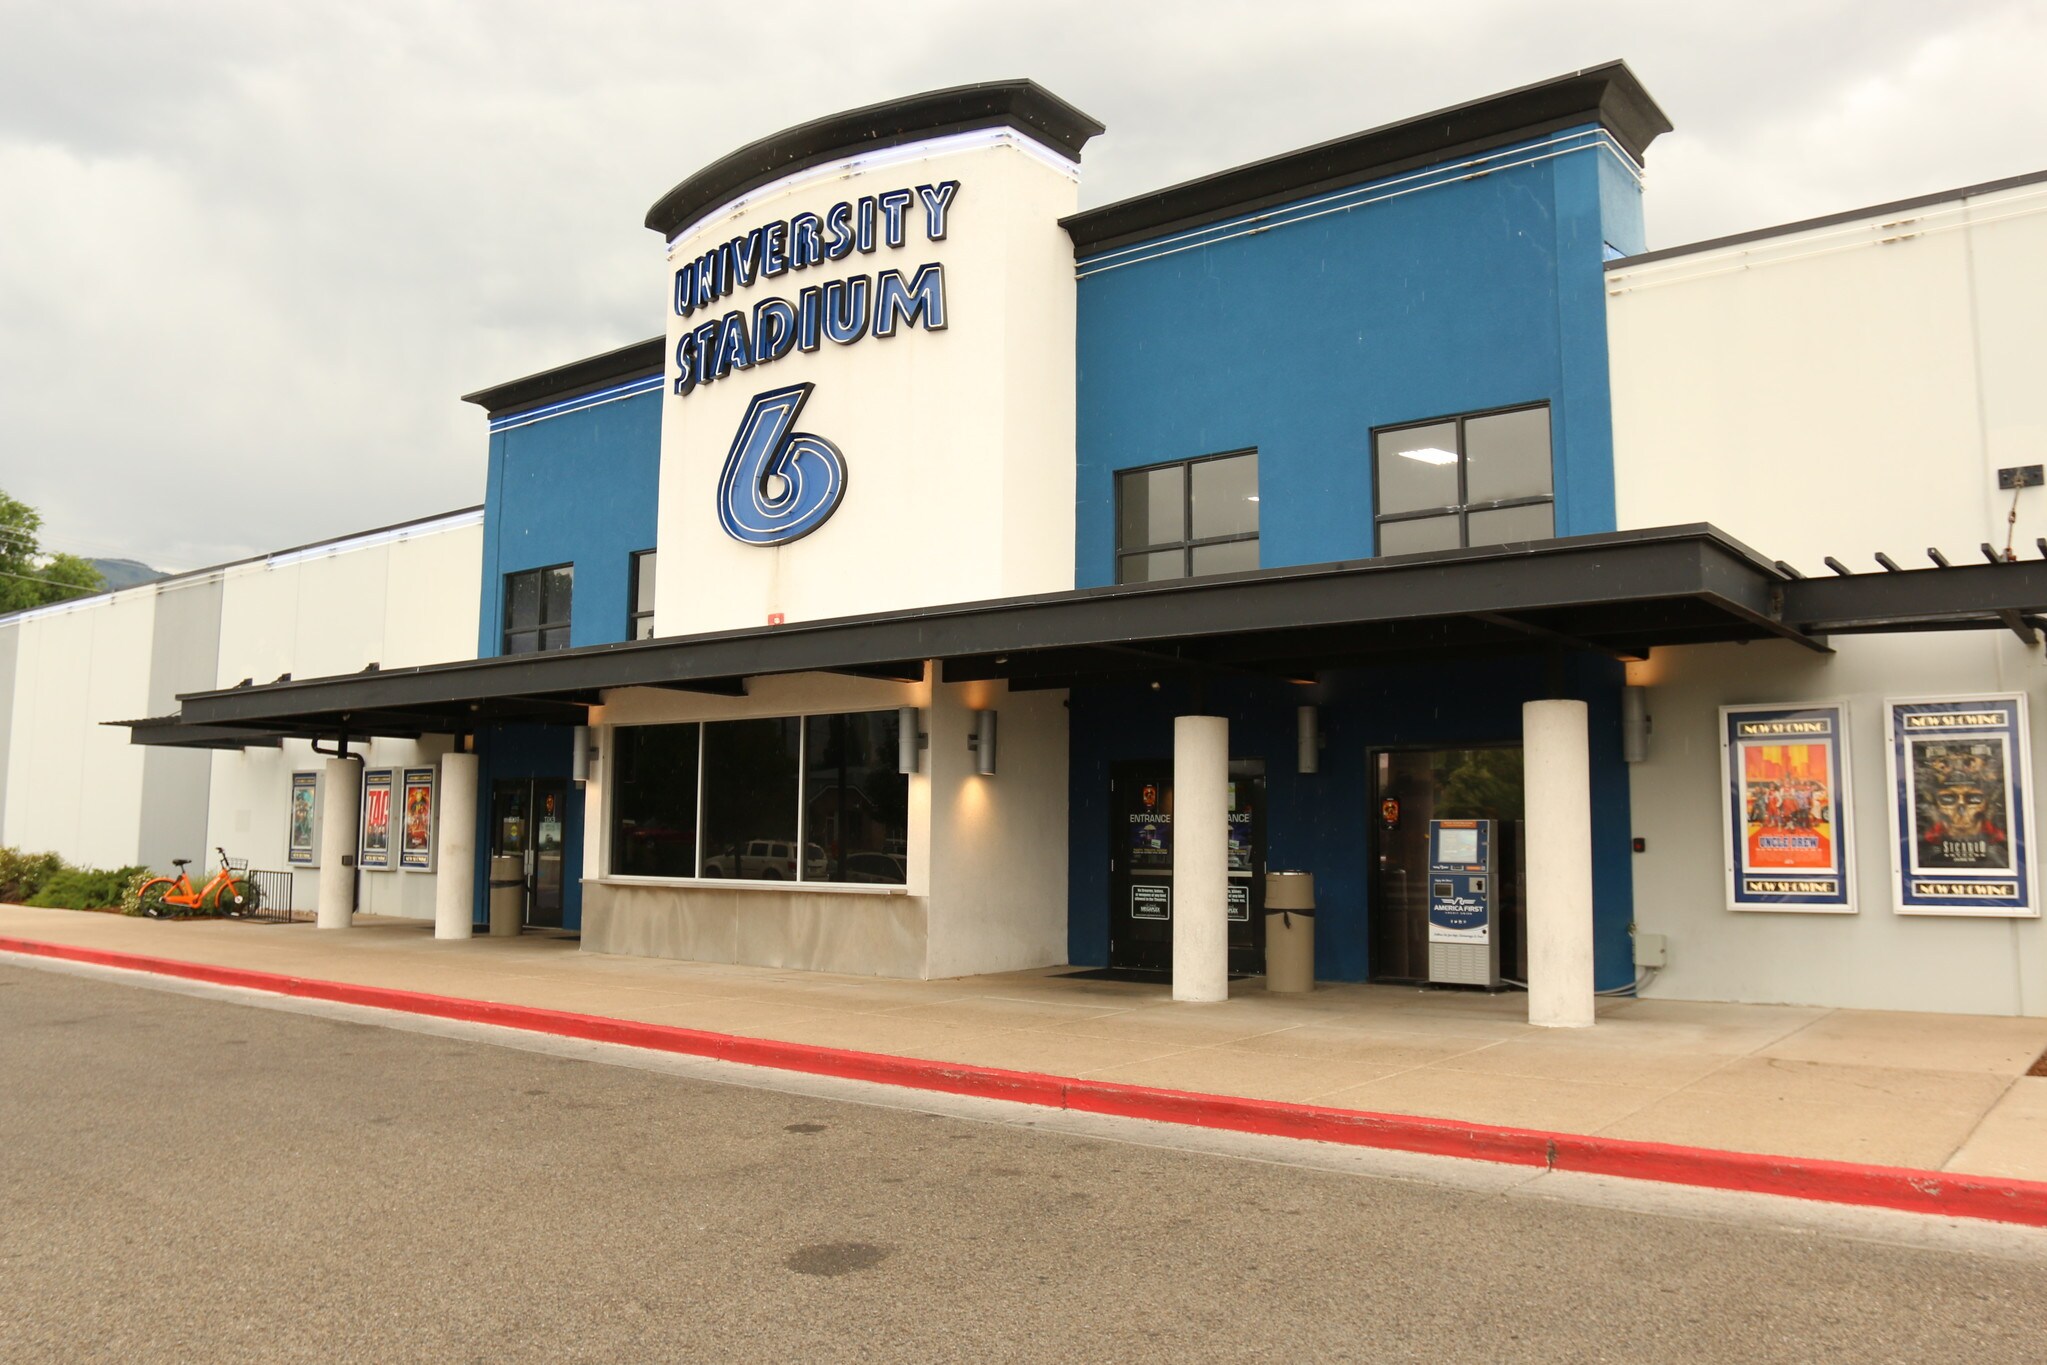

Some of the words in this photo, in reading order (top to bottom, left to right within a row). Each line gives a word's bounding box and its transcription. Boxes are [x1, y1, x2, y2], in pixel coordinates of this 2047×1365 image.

[674, 180, 961, 318] UNIVERSITY
[674, 262, 949, 396] STADIUM
[716, 381, 848, 547] 6
[1910, 715, 1940, 727] NOW
[1743, 723, 1770, 734] NOW
[1771, 721, 1825, 734] SHOWING
[1130, 813, 1171, 823] ENTRANCE
[1228, 812, 1250, 823] ANCE
[1759, 836, 1789, 849] UNCLE
[1791, 836, 1819, 849] DREW
[1942, 840, 1987, 854] SICARIO
[1749, 881, 1776, 893] NOW
[1777, 881, 1833, 893] SHOWING
[1919, 884, 1949, 895] NOW
[1434, 904, 1464, 912] AMERICA
[1464, 905, 1484, 913] FIRST
